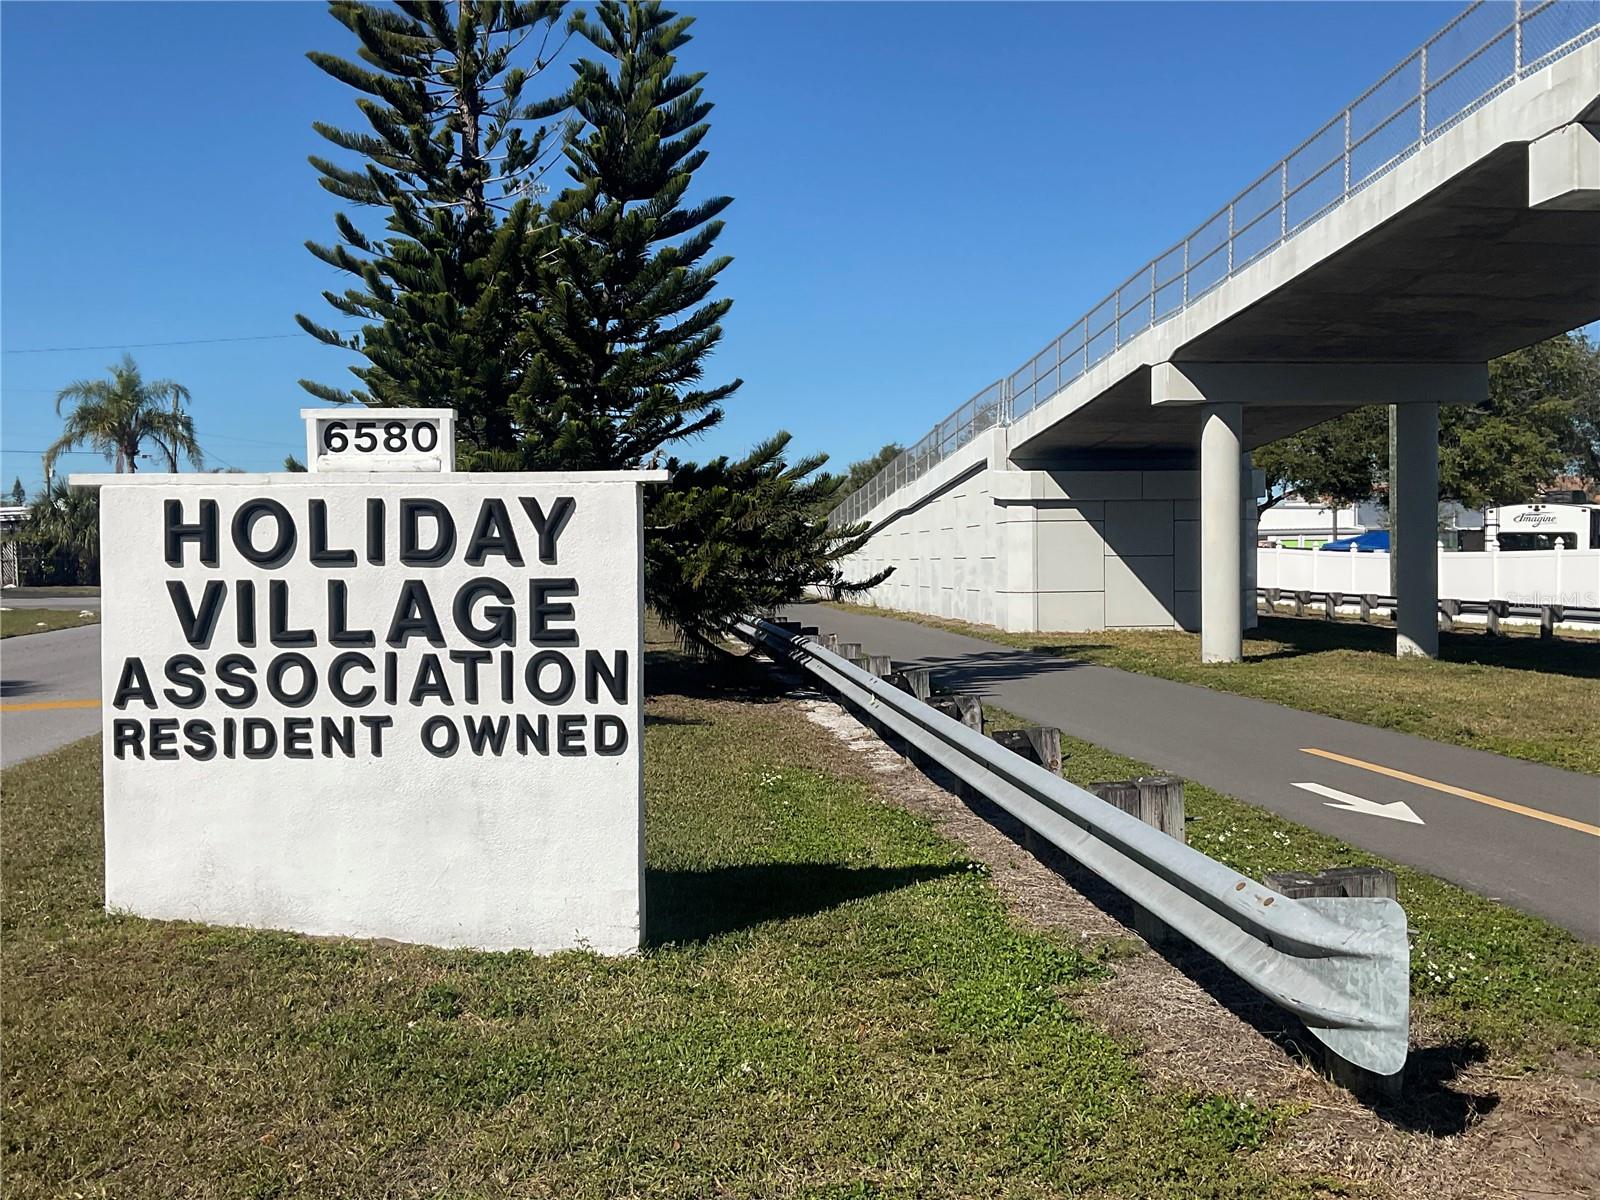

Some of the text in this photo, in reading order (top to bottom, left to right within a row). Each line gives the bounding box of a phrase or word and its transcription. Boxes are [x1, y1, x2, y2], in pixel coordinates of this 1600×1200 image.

[323, 420, 438, 453] 6580
[164, 496, 577, 569] HOLIDAY
[1513, 512, 1557, 528] Imagine
[166, 576, 580, 650] VILLAGE
[113, 649, 629, 711] ASSOCIATION
[113, 713, 629, 761] RESIDENT OWNED
